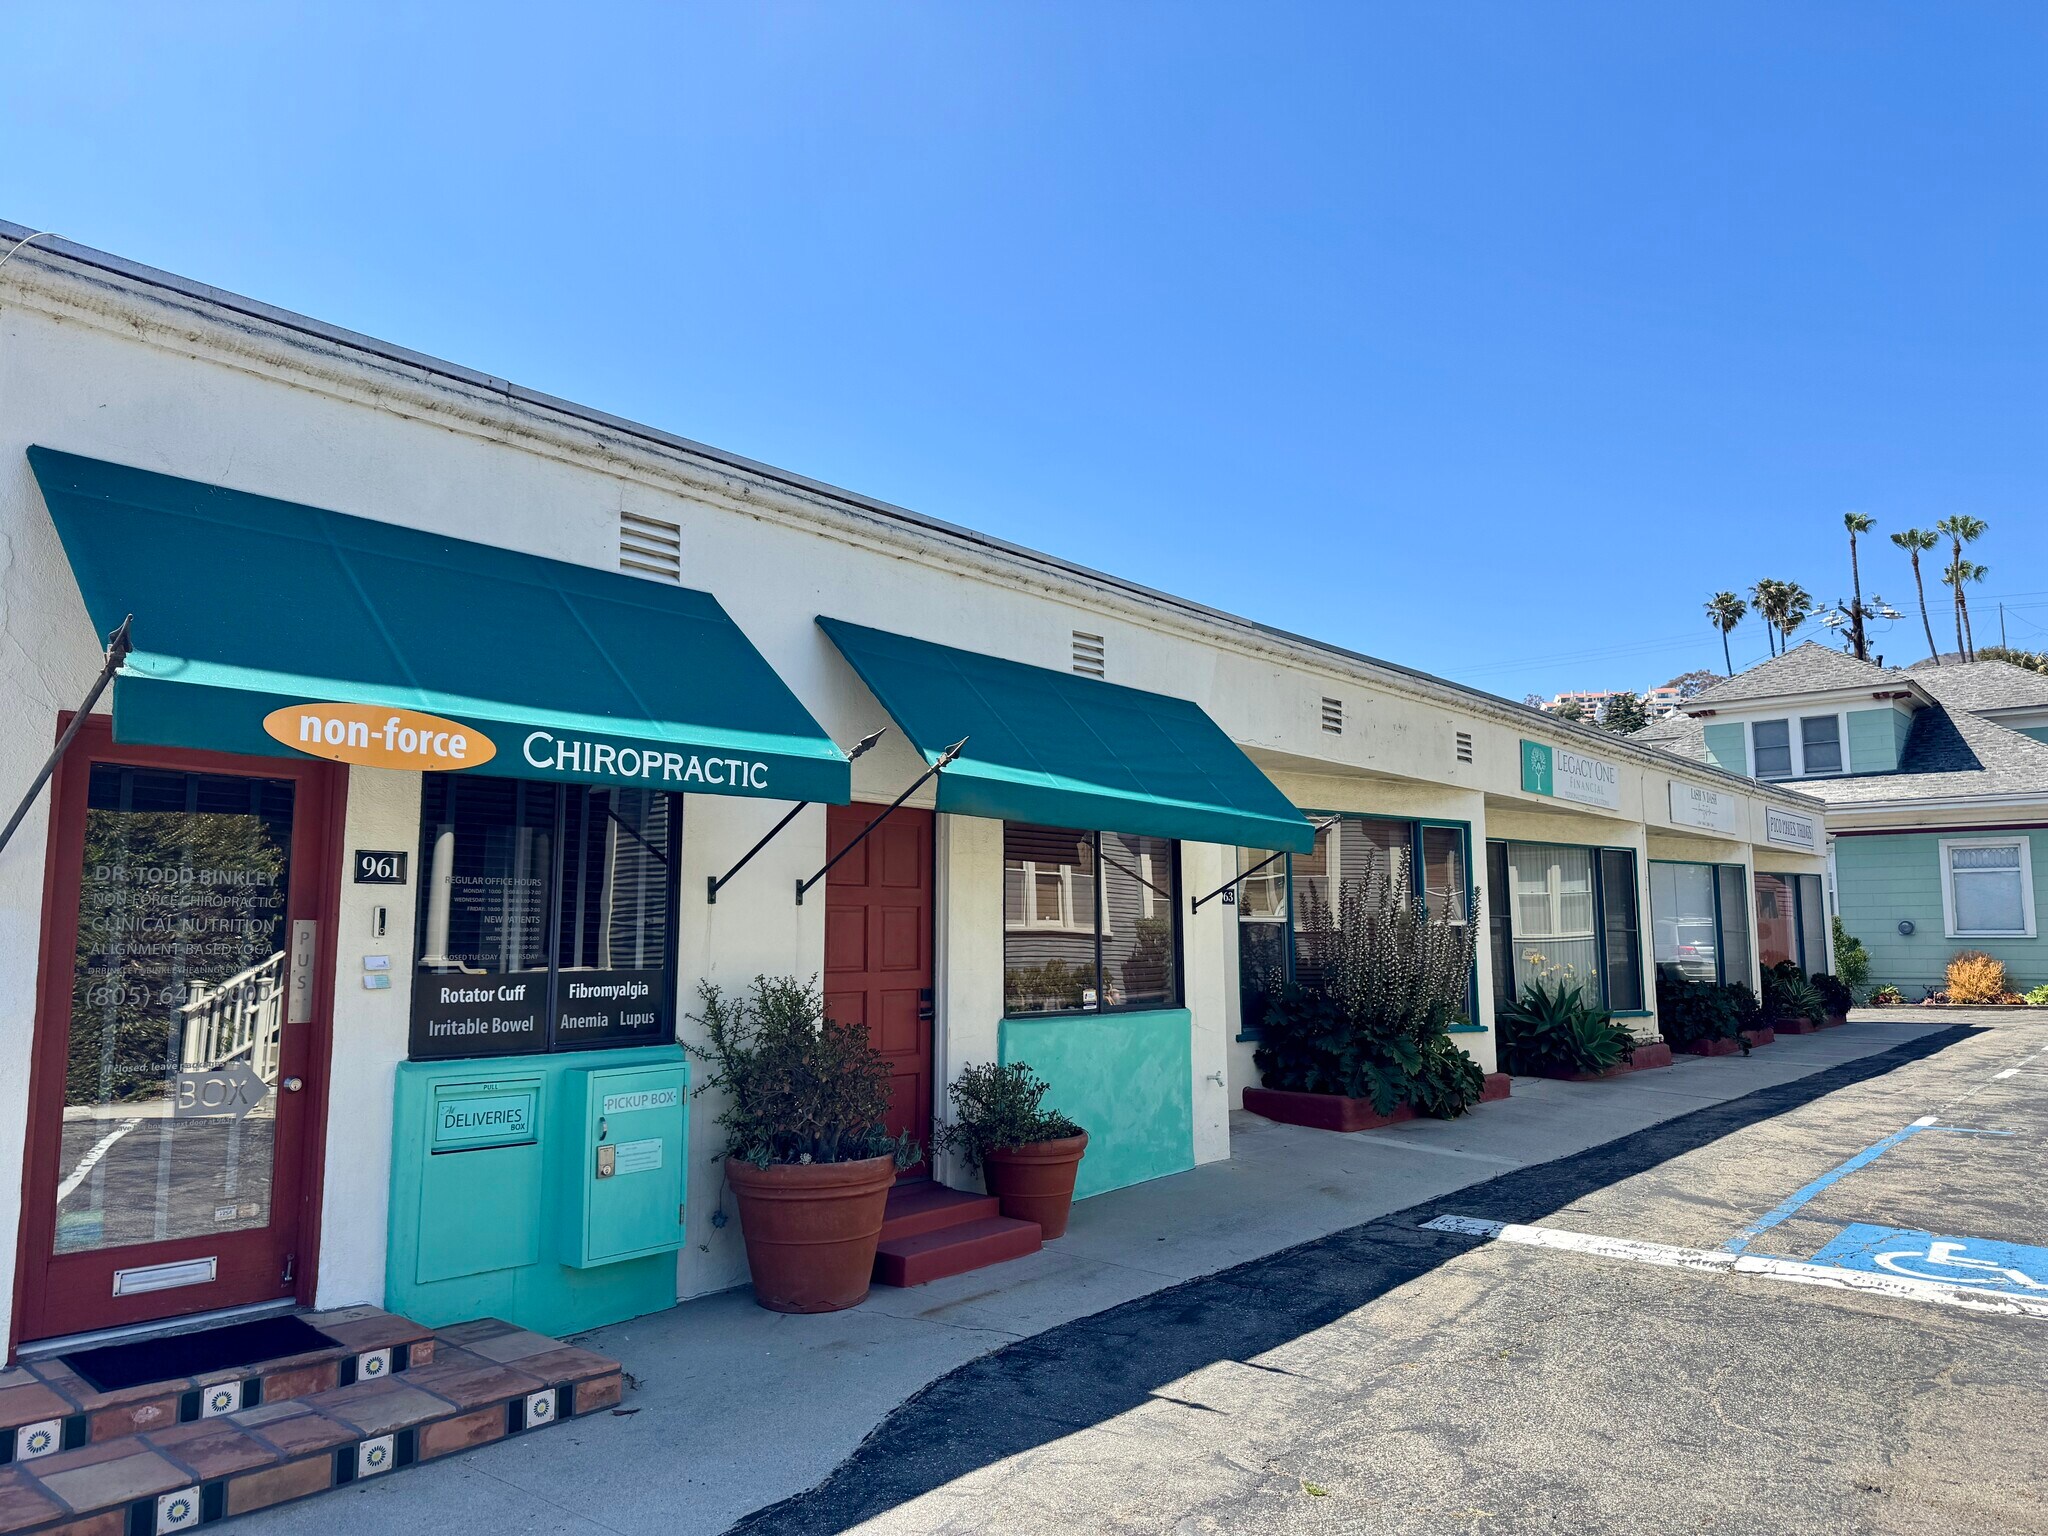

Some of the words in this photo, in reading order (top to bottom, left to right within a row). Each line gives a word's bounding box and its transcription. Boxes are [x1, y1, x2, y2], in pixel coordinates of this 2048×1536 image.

[299, 714, 467, 760] non-force
[523, 731, 769, 790] CHIROPRACTIC
[1557, 750, 1593, 778] LEGACY
[1595, 762, 1615, 784] ONE
[1570, 776, 1604, 795] FINANCIAL
[95, 866, 129, 882] DR.
[136, 867, 194, 884] TODD
[200, 870, 279, 887] BINKLEY
[362, 856, 400, 878] 961
[445, 876, 484, 885] REGULAR
[485, 877, 512, 886] OFFICE
[514, 878, 542, 887] HOURS
[182, 895, 277, 909] CHIROPRACTIC
[92, 917, 172, 932] CLINICAL
[182, 918, 275, 933] NUTRITION
[90, 943, 180, 955] ALIGNMENT
[185, 944, 232, 955] BASED
[235, 944, 273, 955] YOGA
[86, 983, 151, 1008] (805)
[440, 987, 495, 1004] Rotator
[497, 984, 527, 1002] Cuff
[569, 981, 649, 1000] Fibromyalgia
[429, 1017, 489, 1036] Irritable
[492, 1015, 534, 1034] Bowel
[560, 1012, 609, 1030] Anemia
[620, 1010, 655, 1027] Lupus
[114, 1064, 149, 1074] closed,
[152, 1062, 178, 1071] leave
[178, 1078, 248, 1110] BOX
[606, 1095, 648, 1110] PICKUP
[651, 1091, 674, 1105] BOX
[444, 1108, 522, 1128] DELIVERIES
[510, 1122, 525, 1130] BOX
